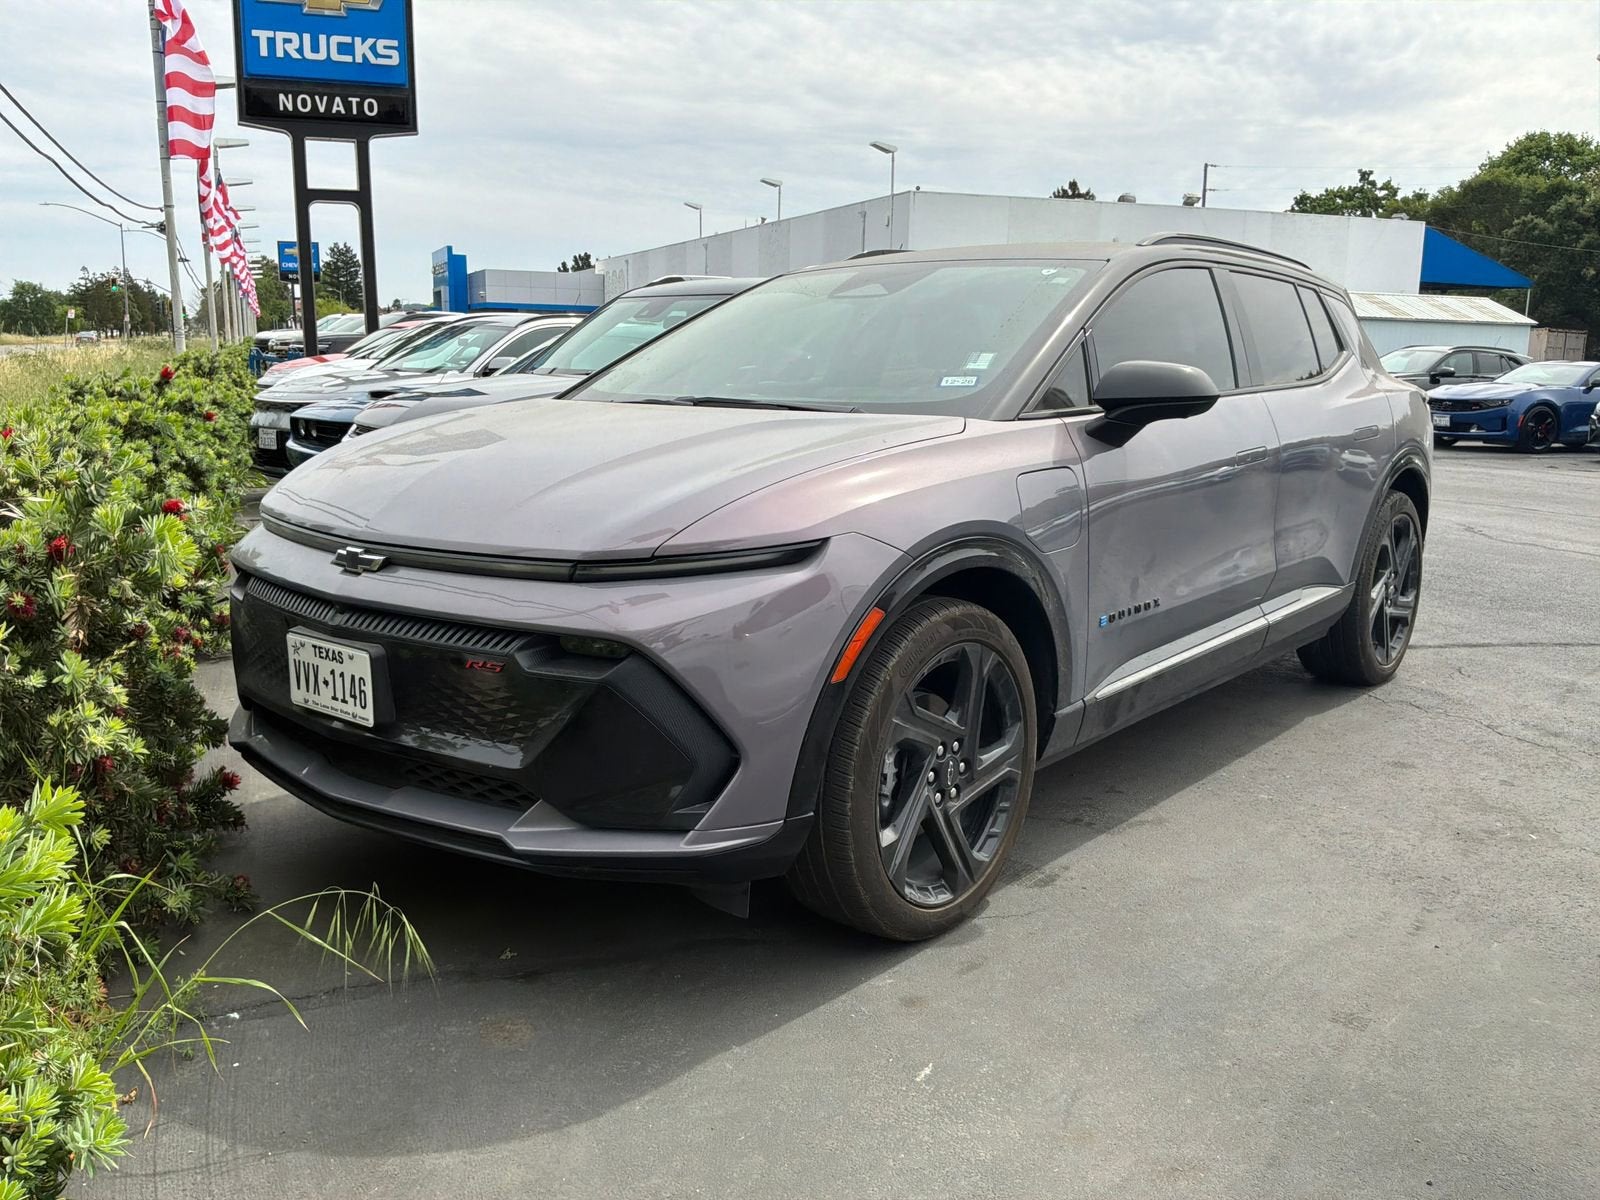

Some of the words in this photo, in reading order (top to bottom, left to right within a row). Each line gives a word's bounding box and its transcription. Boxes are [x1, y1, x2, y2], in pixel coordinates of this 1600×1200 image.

[251, 28, 400, 66] TRUCKS
[278, 93, 378, 117] NOVATO
[281, 262, 318, 270] CHEVT
[1099, 597, 1160, 628] EQUINOX
[311, 644, 344, 665] TEXAS
[465, 658, 506, 674] RS
[320, 702, 330, 710] Lone
[330, 705, 339, 713] Star
